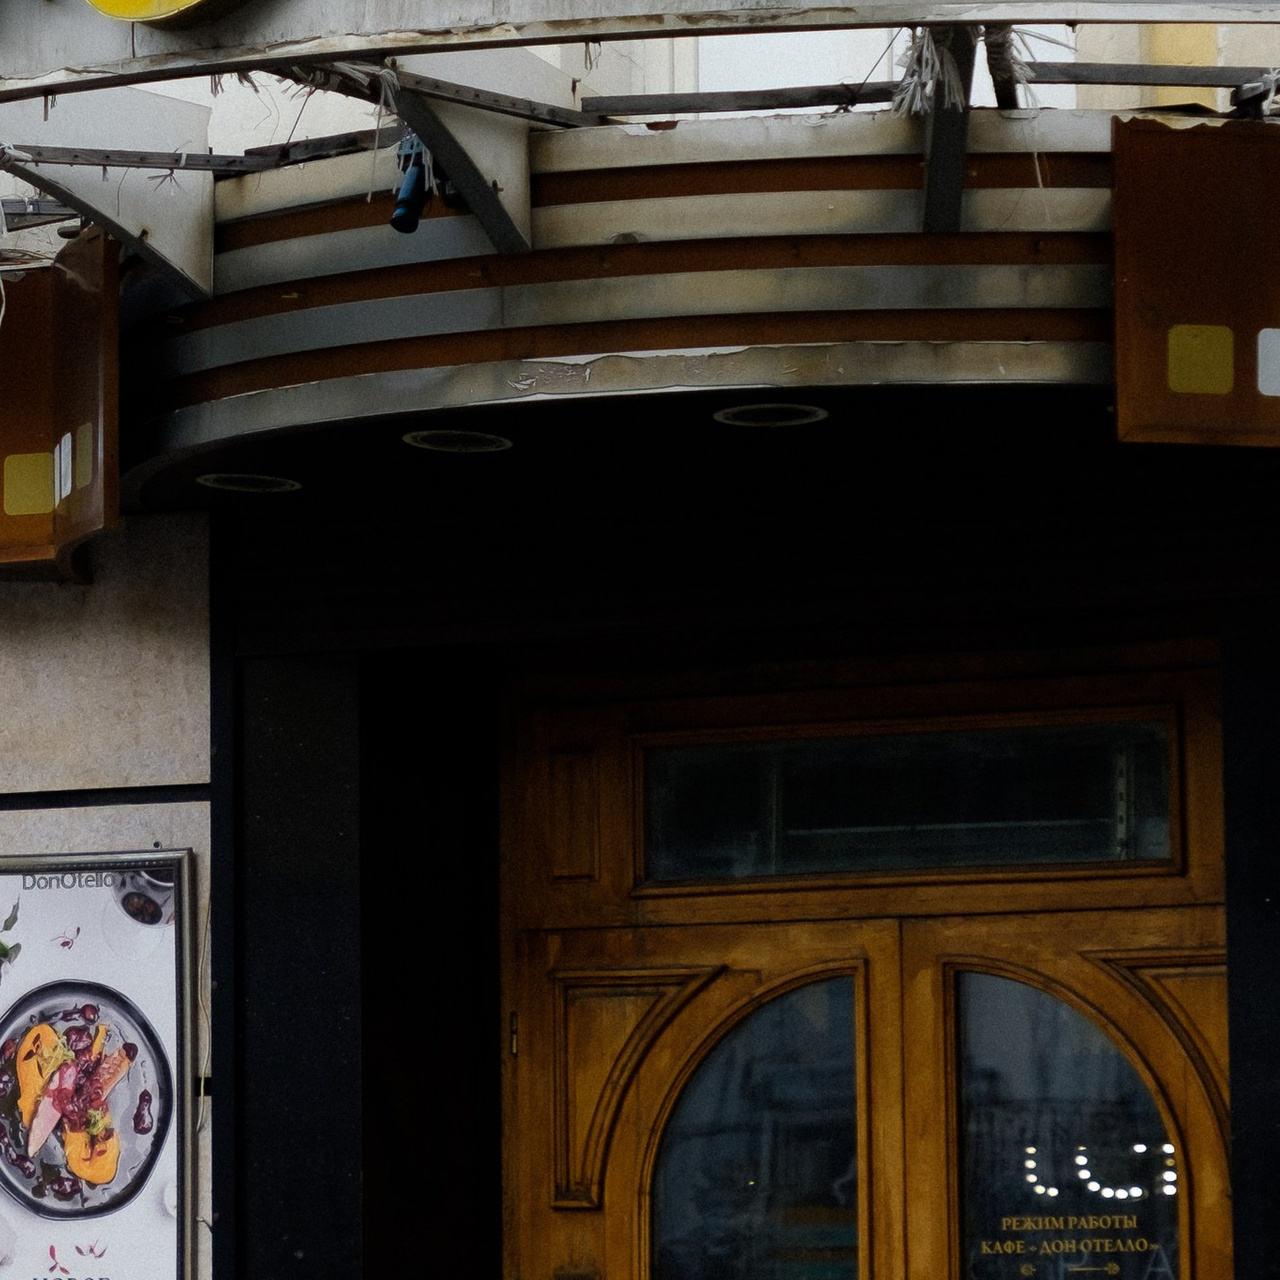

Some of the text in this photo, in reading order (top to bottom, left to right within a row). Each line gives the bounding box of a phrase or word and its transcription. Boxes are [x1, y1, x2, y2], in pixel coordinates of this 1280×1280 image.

[1001, 1215, 1138, 1231] РЕЖИМ РАБОТЫ
[980, 1240, 1026, 1255] КАФЕ
